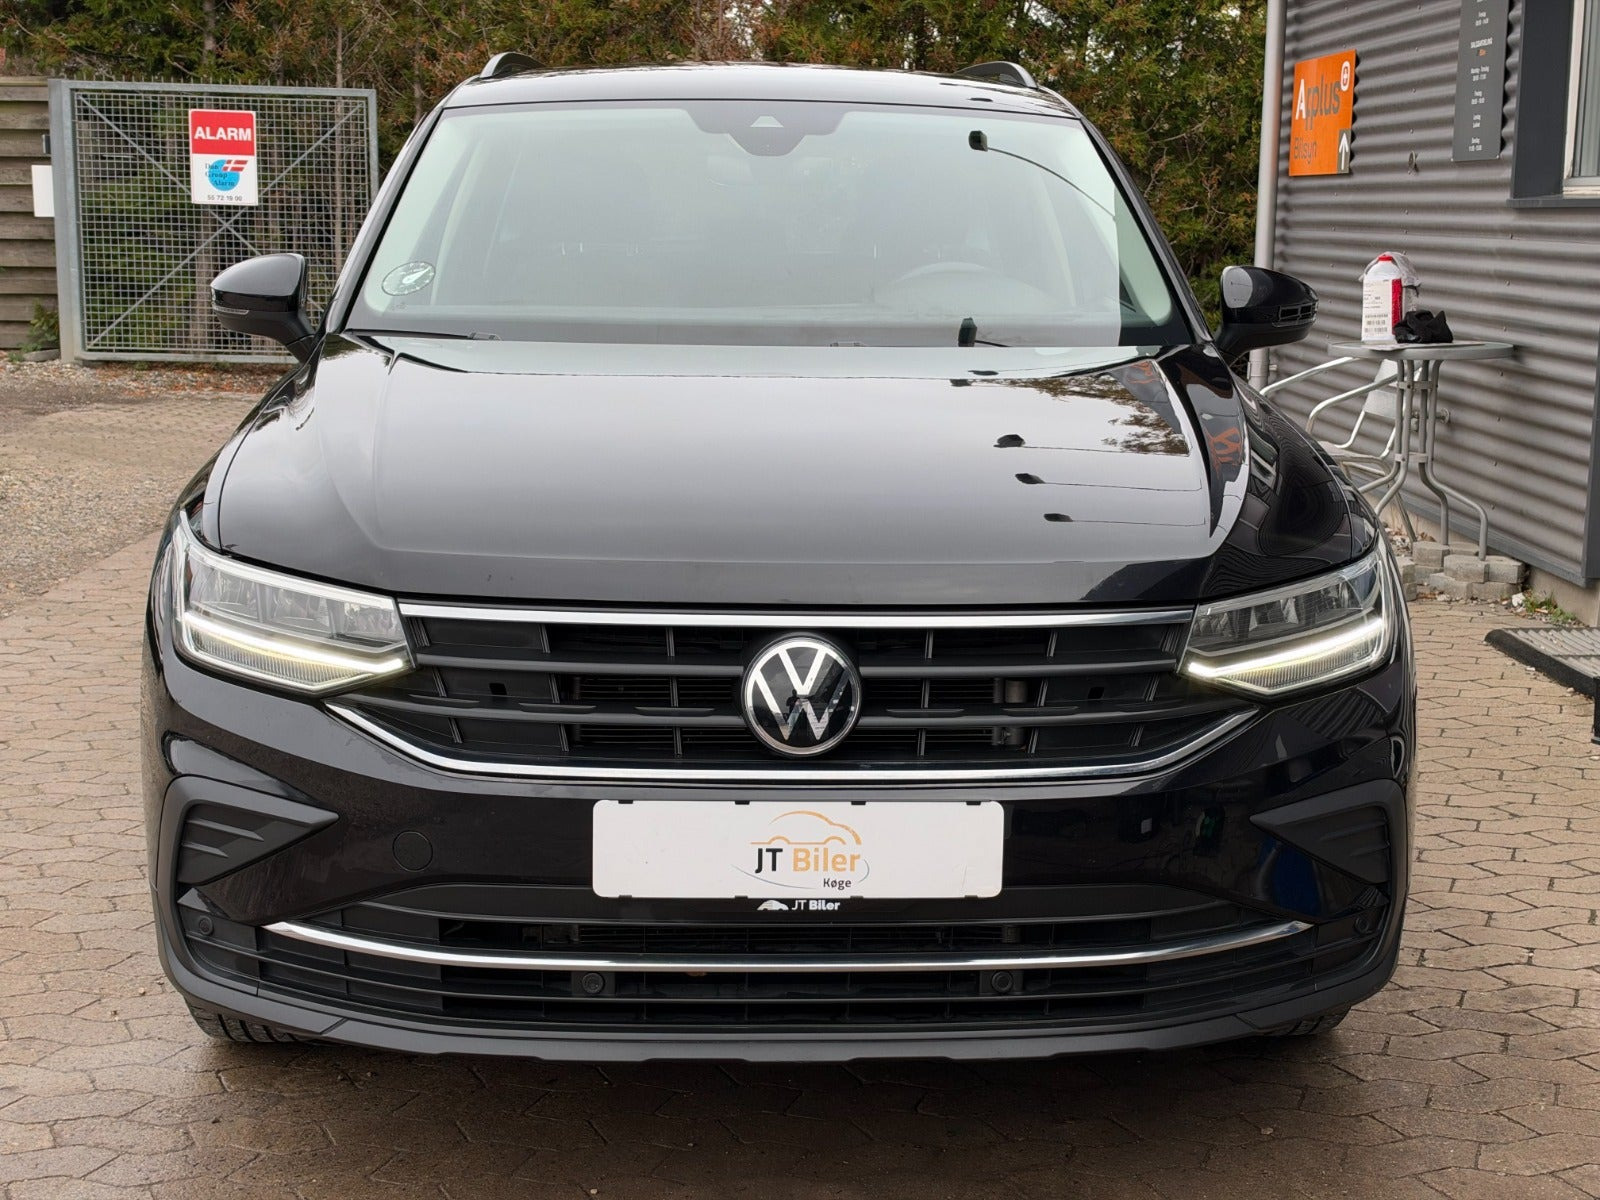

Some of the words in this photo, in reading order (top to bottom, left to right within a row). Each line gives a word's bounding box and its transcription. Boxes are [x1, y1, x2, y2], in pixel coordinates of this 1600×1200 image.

[194, 126, 252, 141] ALARM
[205, 171, 228, 180] Group
[755, 848, 783, 874] JT
[792, 847, 861, 872] Biler
[823, 878, 852, 890] Køge
[792, 900, 807, 911] JT
[808, 899, 841, 911] Biler
